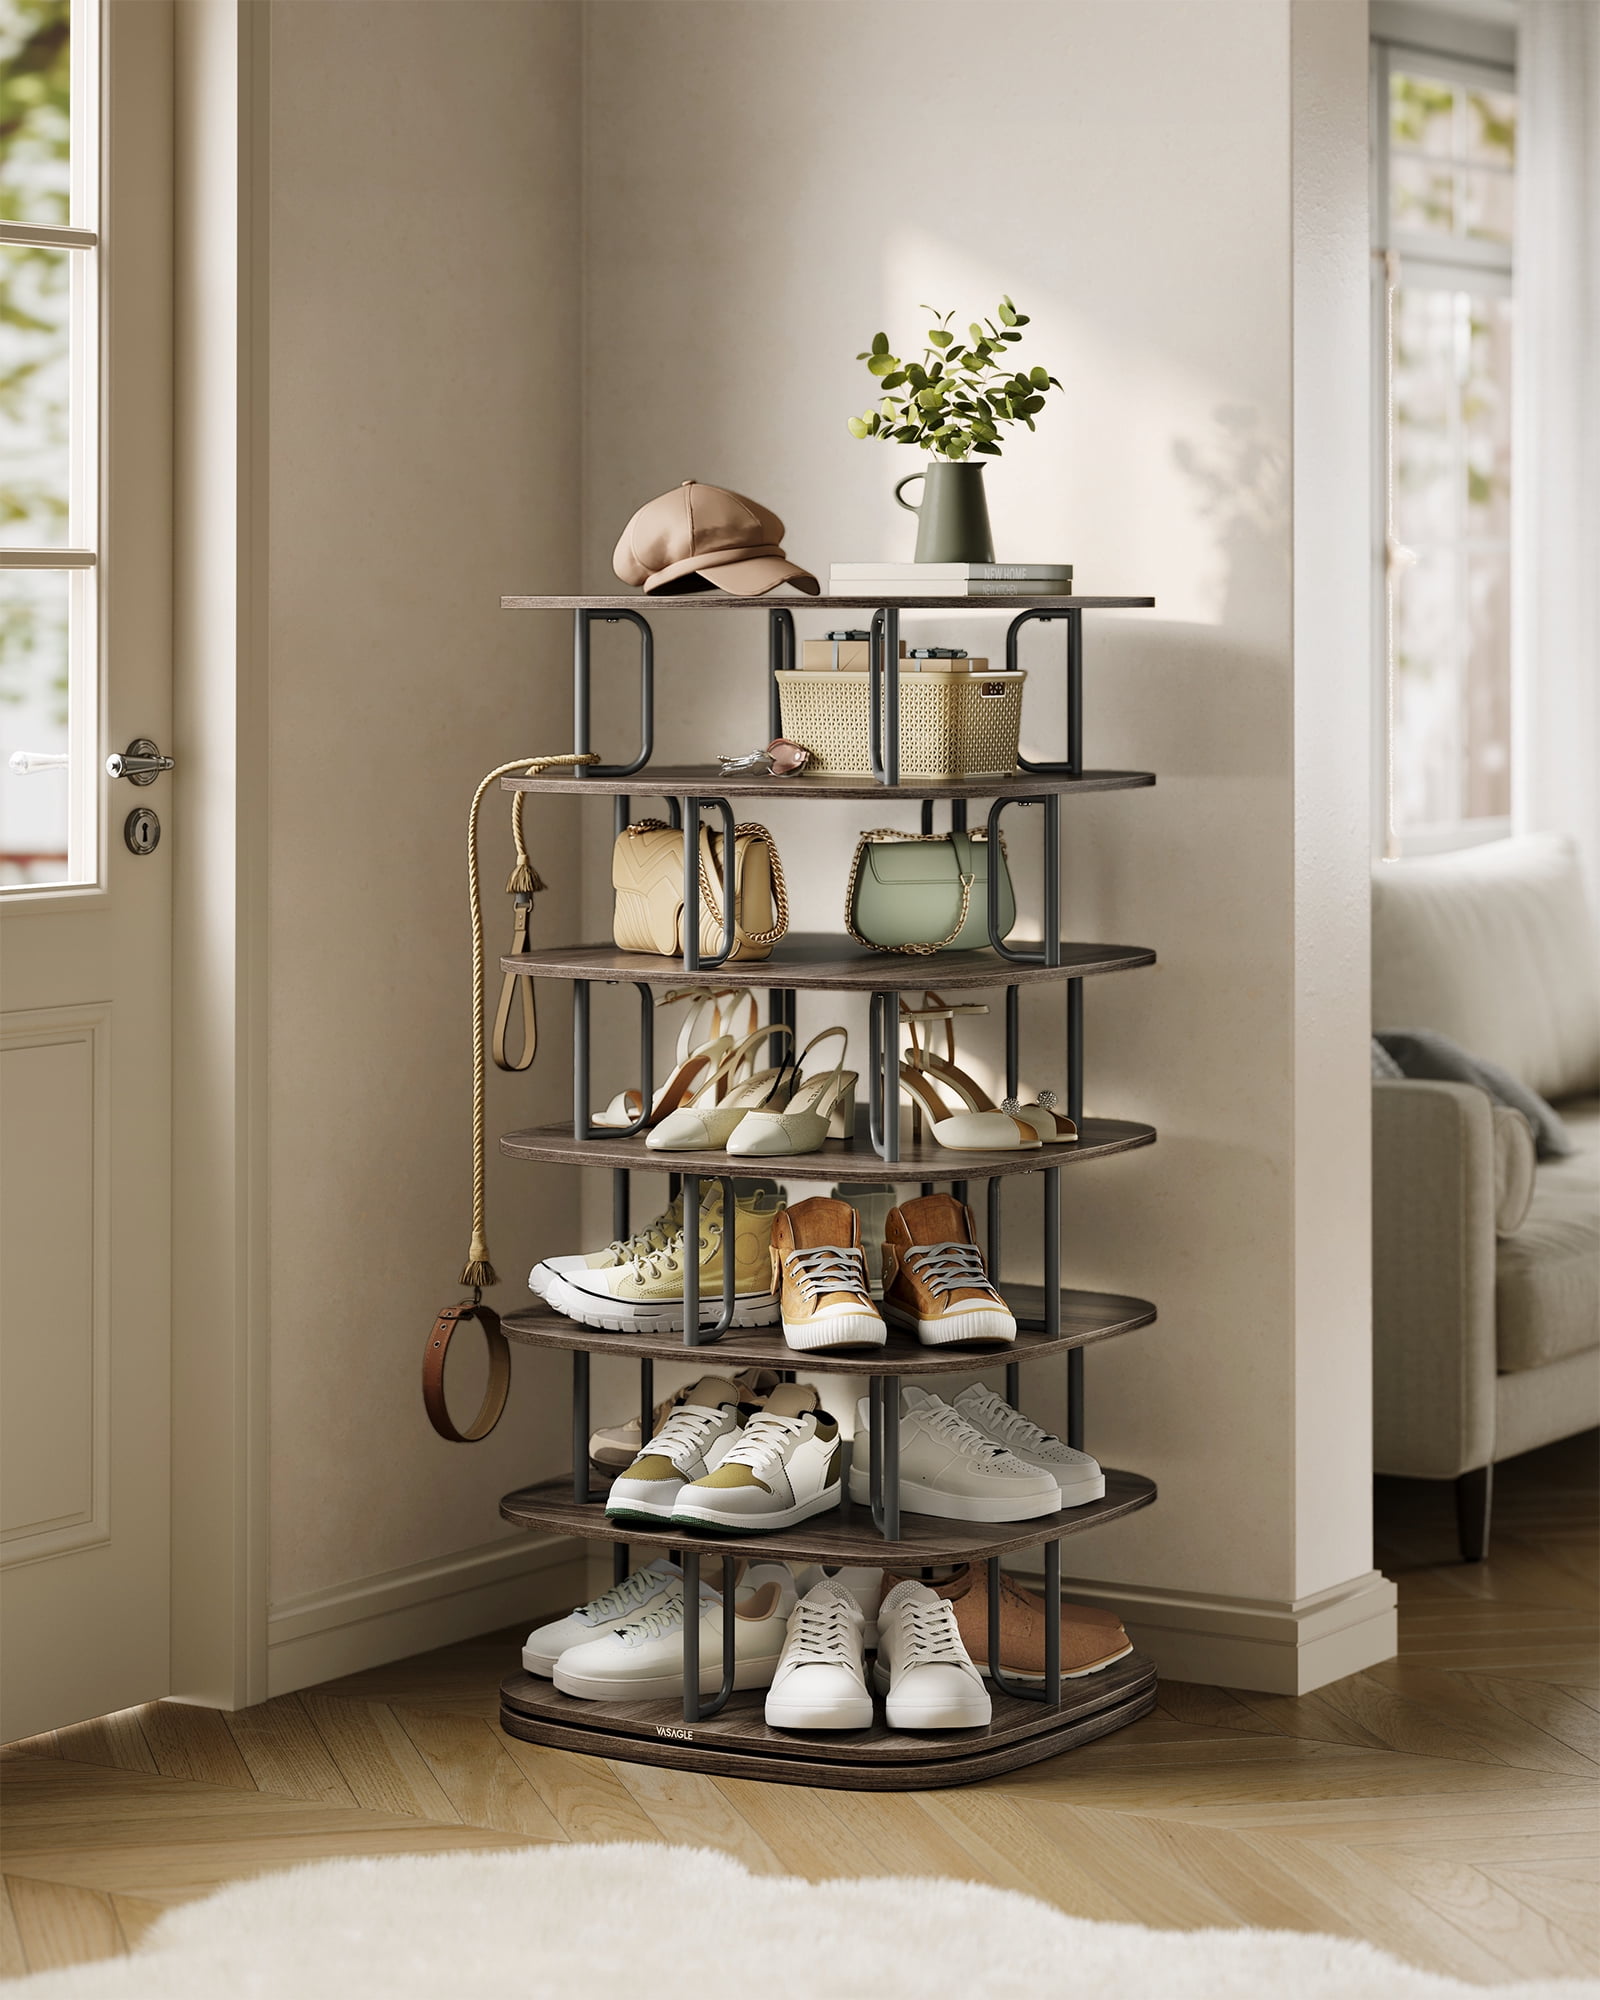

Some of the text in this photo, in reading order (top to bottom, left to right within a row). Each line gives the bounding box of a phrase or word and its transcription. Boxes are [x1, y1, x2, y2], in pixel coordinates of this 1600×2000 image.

[984, 567, 1027, 579] NEW HOME
[656, 1725, 694, 1740] VASAGLE
